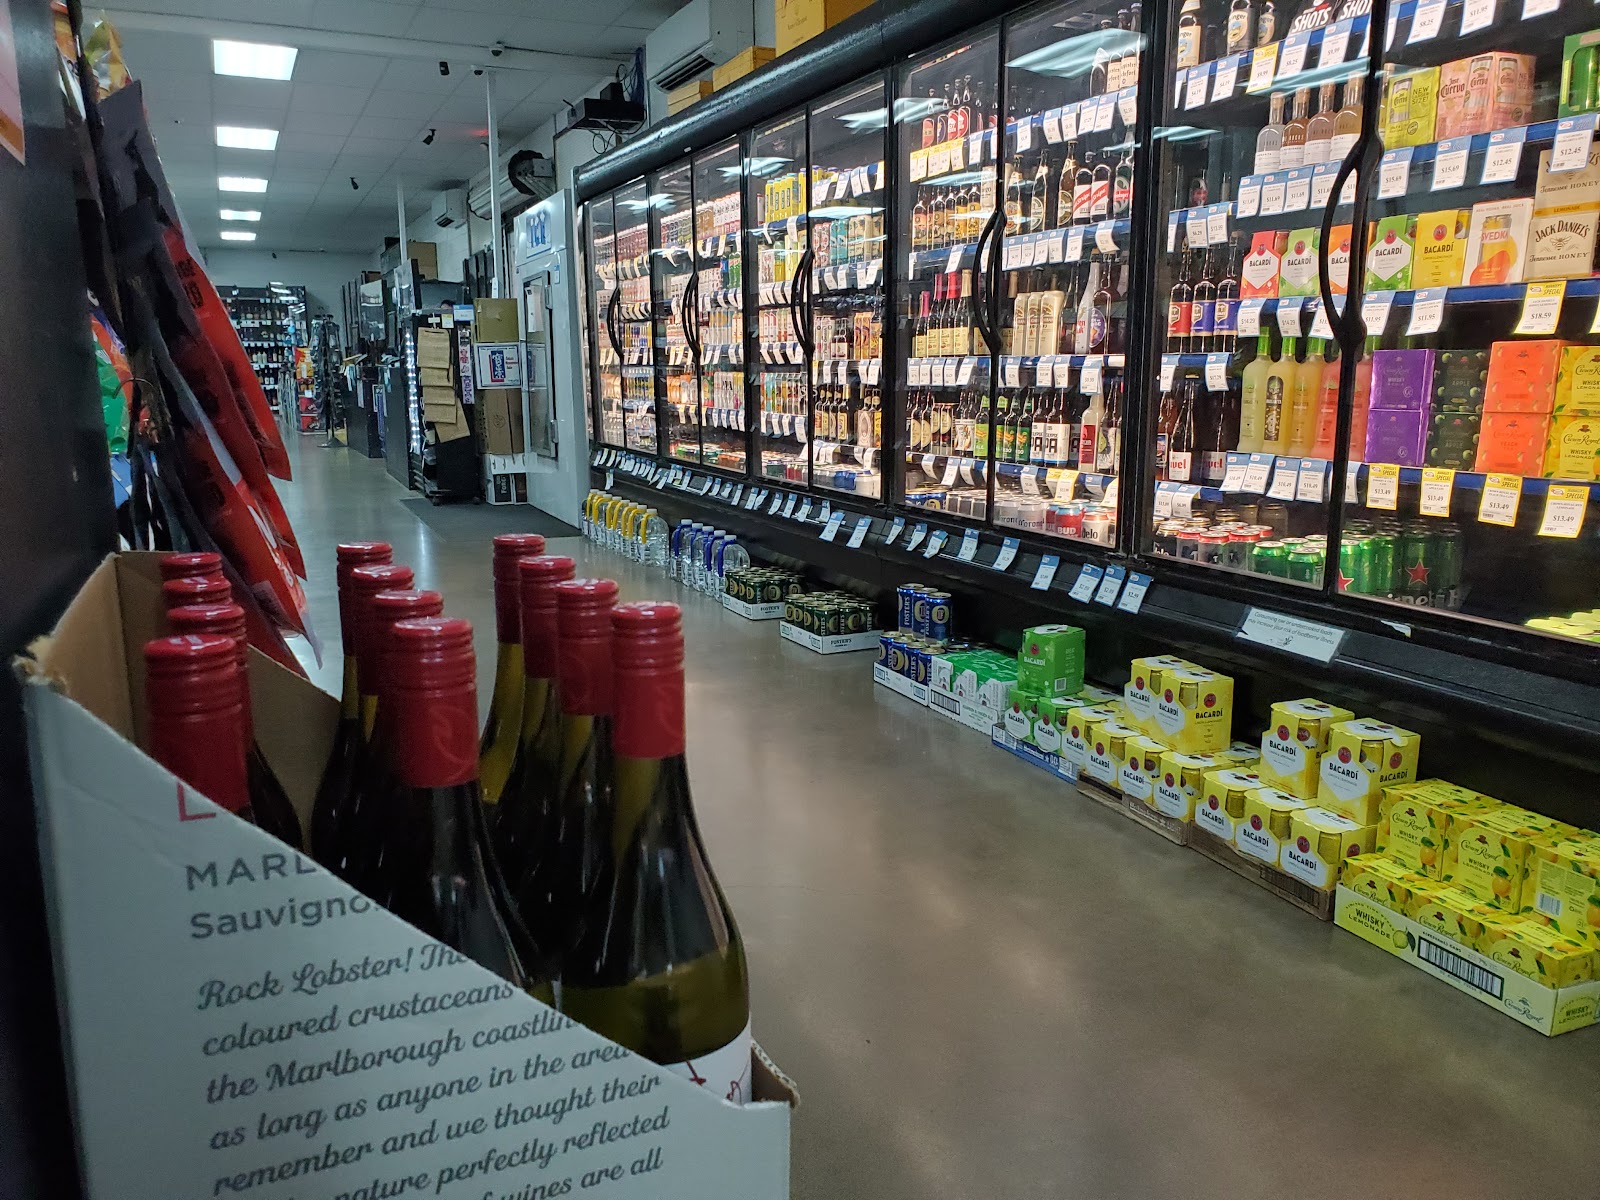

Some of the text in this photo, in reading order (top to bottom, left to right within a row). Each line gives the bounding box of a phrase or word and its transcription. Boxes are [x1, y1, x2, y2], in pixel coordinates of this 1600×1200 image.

[1292, 7, 1332, 33] SHOTS
[1412, 87, 1429, 95] NEW
[1440, 83, 1465, 98] Cuervo
[1412, 97, 1428, 105] SIZE!
[1560, 147, 1582, 156] $12.45
[1441, 165, 1460, 173] $15.69
[1492, 158, 1512, 167] $12.45
[1540, 180, 1599, 193] Tennessee HONEY
[1535, 220, 1590, 242] JACK DANIEL'S
[1375, 245, 1403, 257] BACARDÍ
[1424, 241, 1454, 254] BACARDÍ
[1250, 257, 1271, 267] BACARDÍ
[1287, 255, 1312, 266] BACARDÍ
[1559, 252, 1590, 260] HONEY
[1417, 314, 1436, 322] $11.95
[1531, 312, 1552, 320] $18.59
[1563, 434, 1582, 445] Crown
[1489, 502, 1510, 510] $13.49
[1552, 515, 1574, 523] $13.49
[1057, 527, 1077, 535] BUD
[1254, 611, 1277, 622] Consuming
[1024, 656, 1046, 667] BACARDÍ
[1130, 690, 1151, 703] BACARDÍ
[1159, 703, 1179, 717] BACARDÍ
[1195, 708, 1223, 719] BACARDÍ
[1008, 713, 1025, 725] BACARDÍ
[1038, 725, 1055, 738] BACARDÍ
[1066, 737, 1085, 751] BACARDÍ
[1269, 739, 1297, 756] BACARDÍ
[1090, 755, 1110, 769] BACARDÍ
[1123, 770, 1145, 784] BACARDÍ
[1329, 762, 1359, 780] BACARDÍ
[1380, 768, 1408, 783] BACARDÍ
[1159, 786, 1181, 802] BACARDÍ
[1202, 808, 1225, 826] BACARDÍ
[1407, 817, 1427, 833] Royal
[1243, 829, 1269, 847] BACARDÍ
[1399, 829, 1418, 841] WHISKY
[1461, 839, 1501, 861] Crown Royal
[1289, 851, 1317, 871] BACARDÍ
[1469, 858, 1490, 871] WHISKY
[186, 853, 317, 891] MARL
[1463, 862, 1494, 877] LEMONADE
[191, 894, 379, 939] Sauvigno
[1356, 909, 1384, 929] WHISKY
[1349, 914, 1391, 940] LEMONADE
[197, 948, 413, 1010] Rock Lobster!
[1504, 998, 1521, 1012] Crown
[1520, 1005, 1544, 1023] Royal
[1566, 1005, 1589, 1017] WHISKY
[202, 980, 514, 1056] coloured crustaceans
[207, 1009, 573, 1104] the Marlborough coastlin
[210, 1126, 247, 1150] as
[257, 1112, 327, 1139] long
[334, 1098, 368, 1122] as
[377, 1074, 482, 1114] anyone
[488, 1066, 516, 1088] in
[523, 1054, 565, 1080] the
[213, 1073, 661, 1197] remember and we thought their
[435, 1138, 558, 1194] perfectly
[563, 1105, 670, 1154] reflected
[581, 1165, 625, 1188] are
[630, 1147, 663, 1176] all
